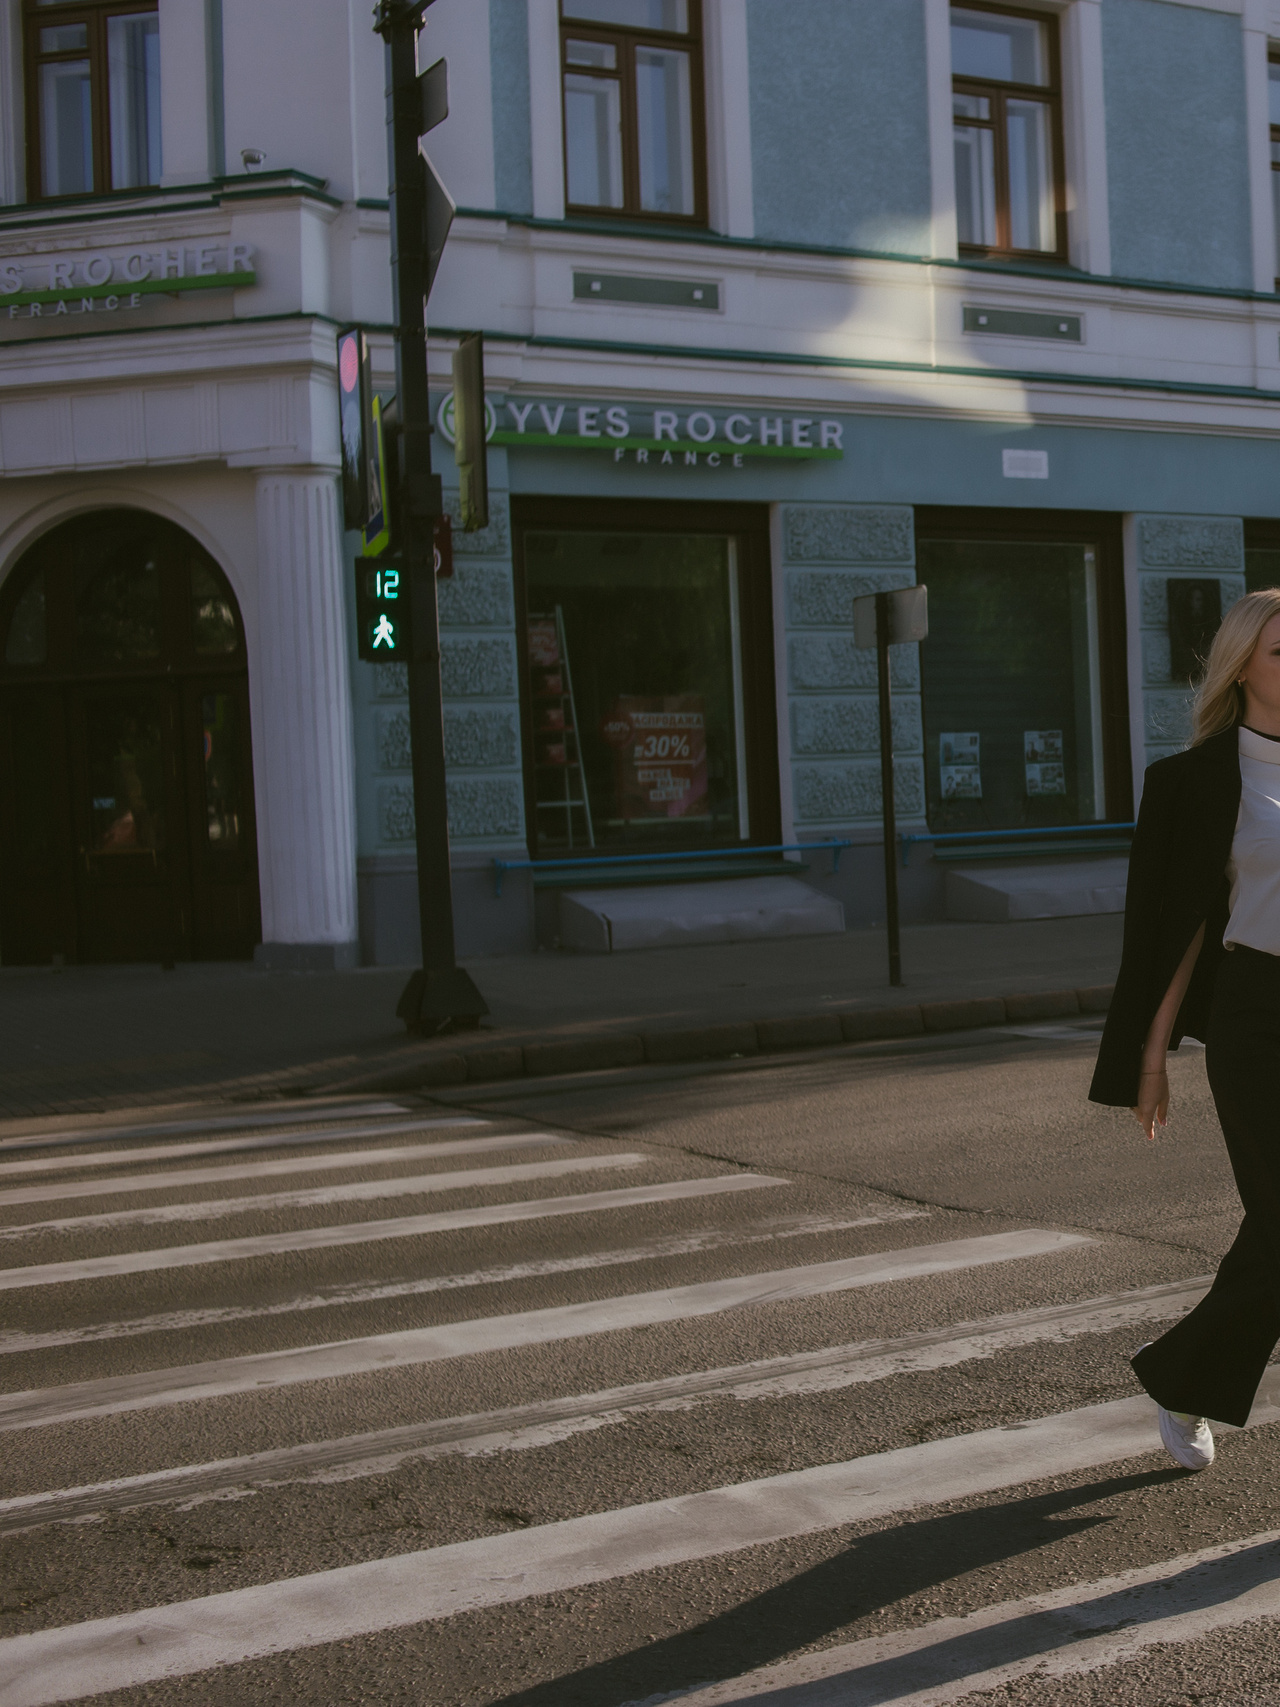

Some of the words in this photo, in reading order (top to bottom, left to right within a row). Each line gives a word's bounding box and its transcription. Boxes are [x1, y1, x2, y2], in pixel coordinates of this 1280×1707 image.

[50, 242, 256, 291] ROCHER
[9, 294, 141, 319] FRANCE
[507, 402, 630, 438] YVES
[654, 410, 844, 449] ROCHER
[614, 448, 744, 468] FRANCE
[376, 570, 399, 599] 12
[632, 715, 702, 726] АСПРОДАЖА
